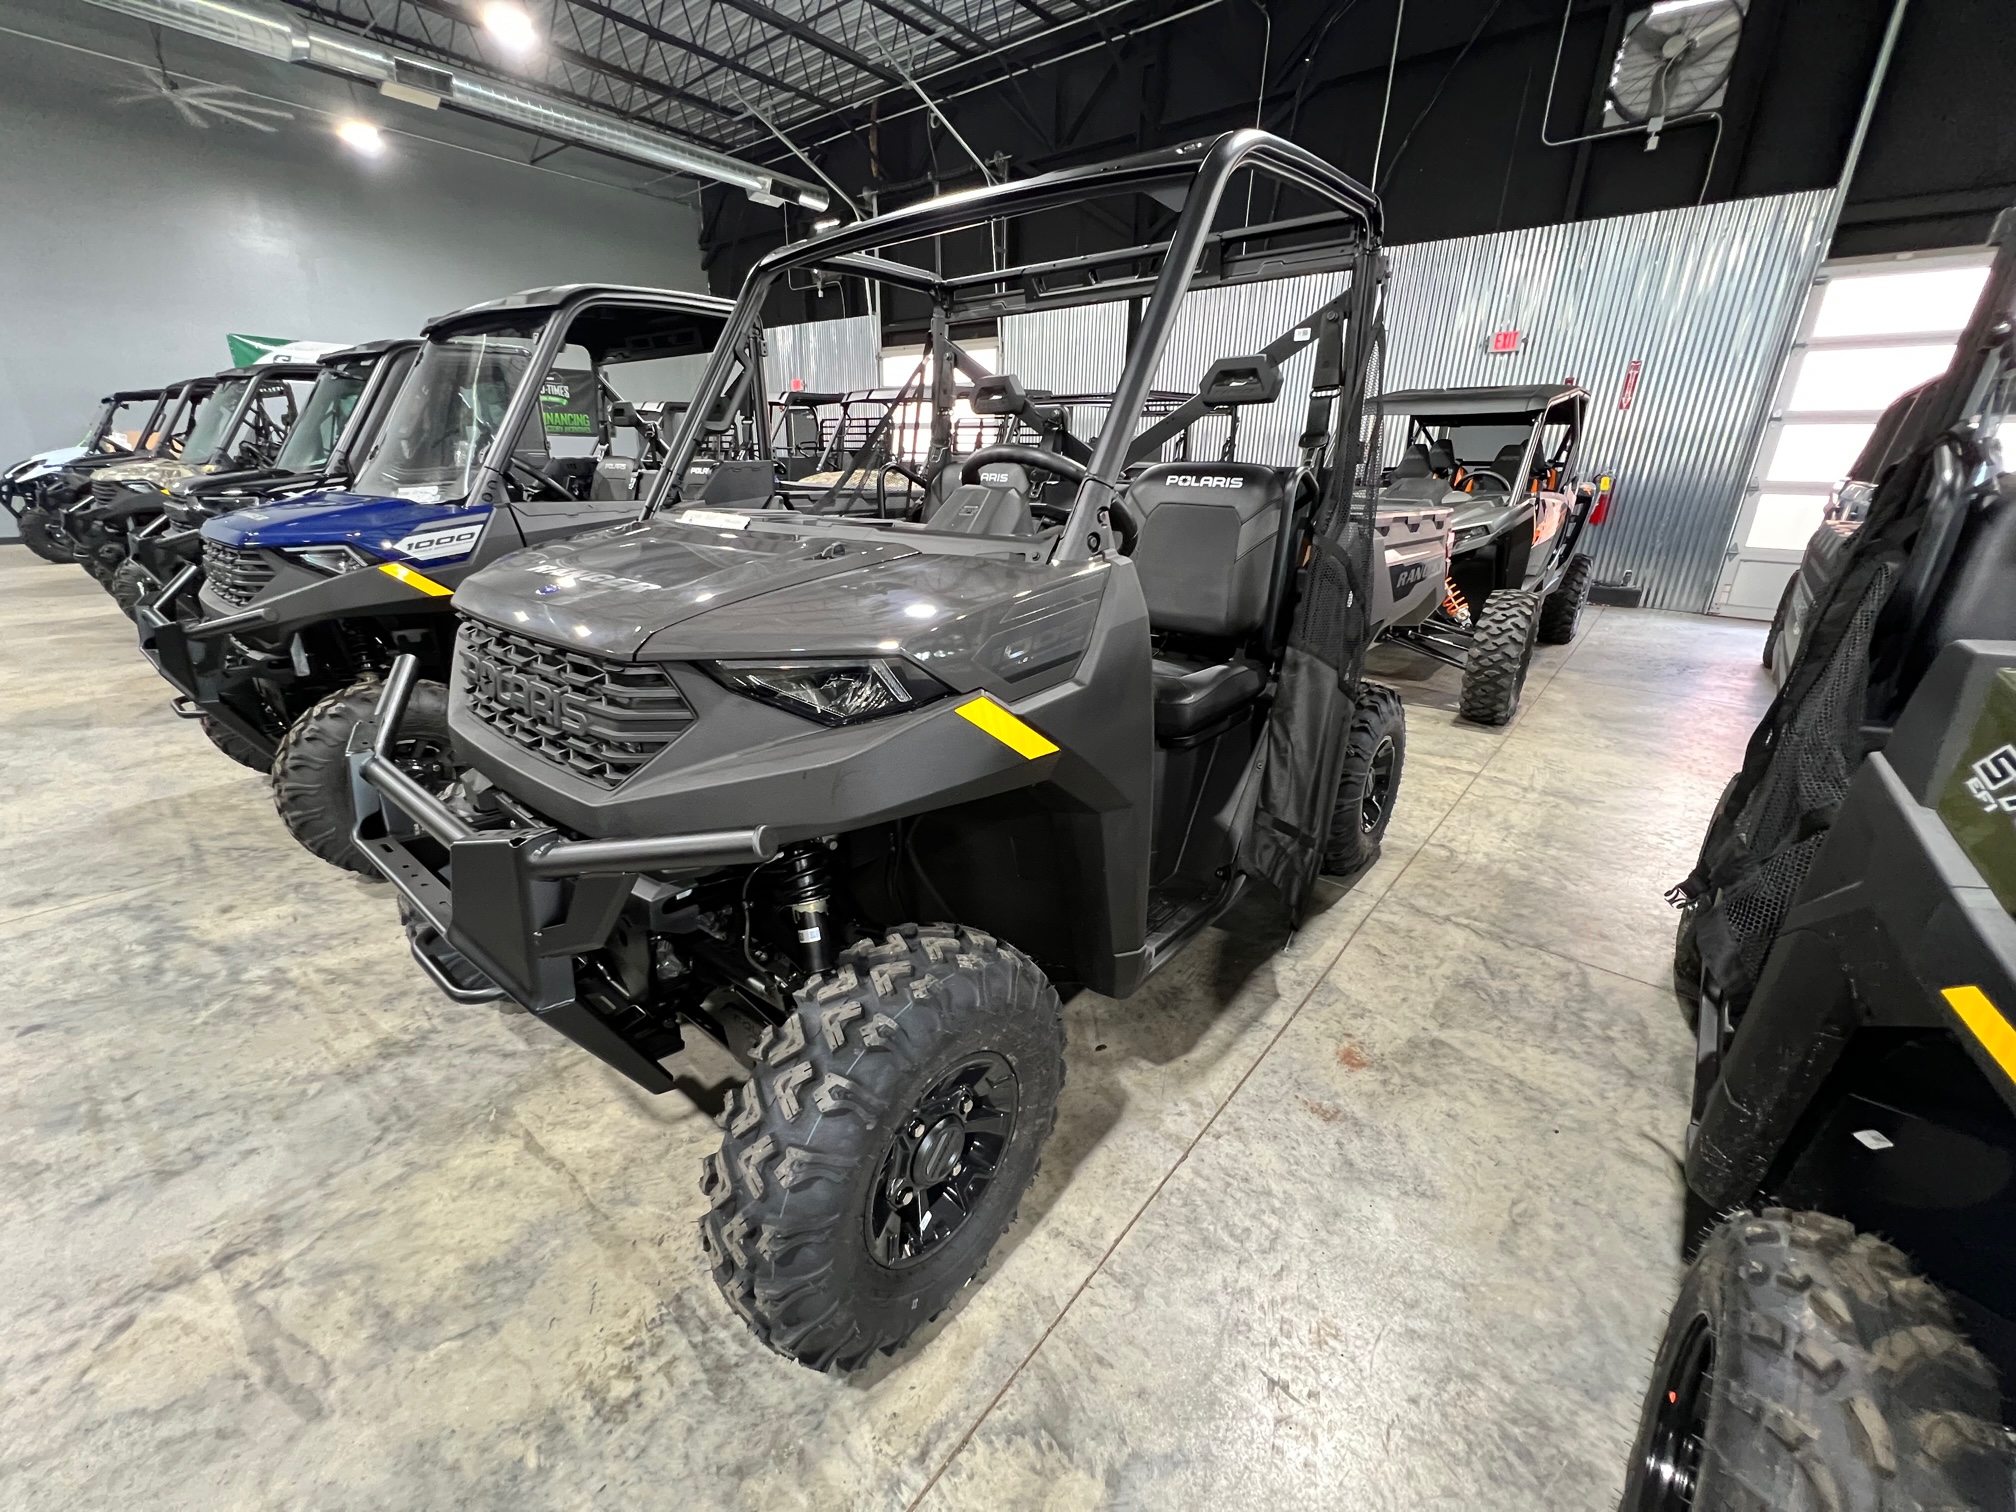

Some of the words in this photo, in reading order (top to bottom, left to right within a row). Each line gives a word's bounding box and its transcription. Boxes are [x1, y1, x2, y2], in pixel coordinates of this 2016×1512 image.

[1494, 331, 1519, 350] EXIT
[543, 412, 590, 427] INANCING
[1165, 474, 1244, 489] POLARIS
[406, 532, 476, 551] 1000
[460, 650, 588, 738] POLARIS
[1963, 776, 1998, 813] EFI
